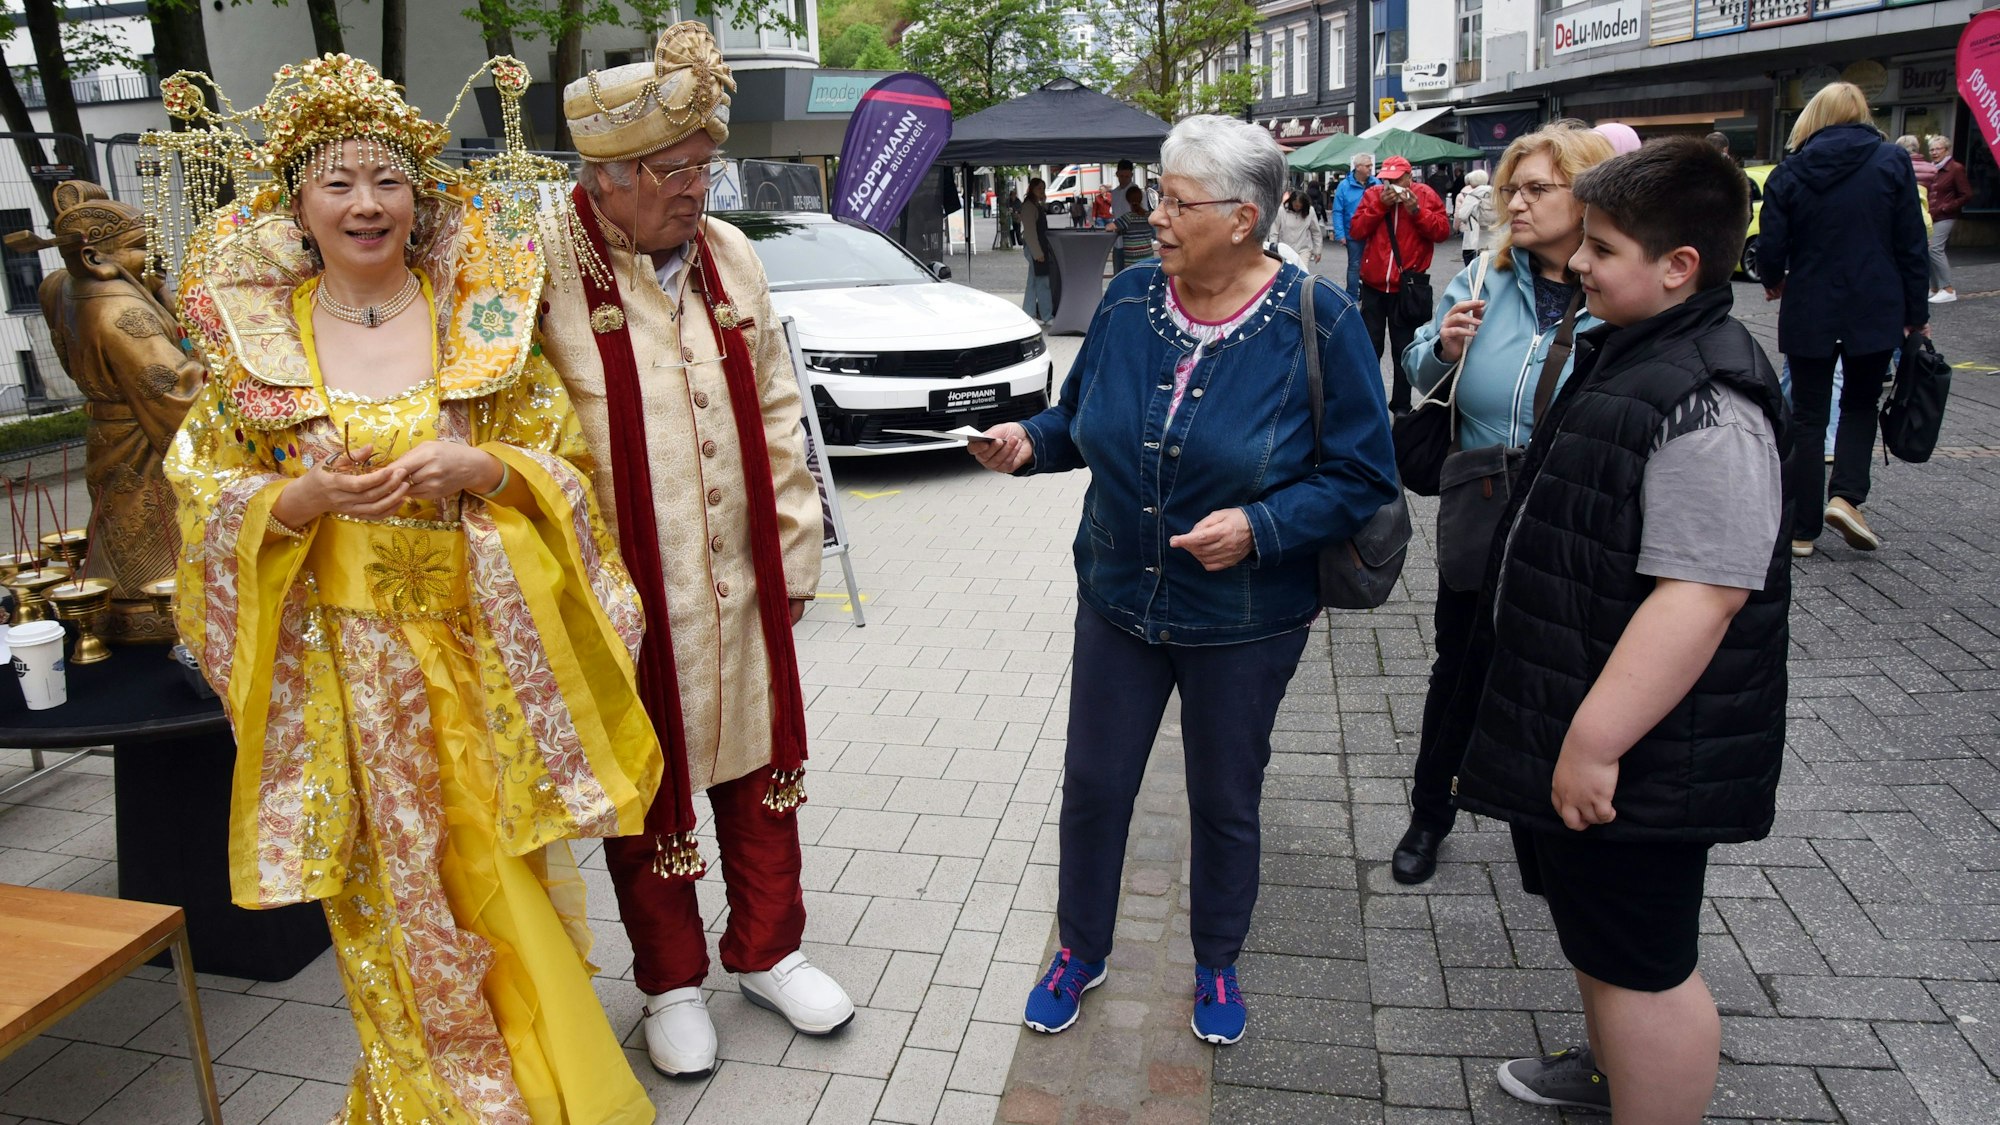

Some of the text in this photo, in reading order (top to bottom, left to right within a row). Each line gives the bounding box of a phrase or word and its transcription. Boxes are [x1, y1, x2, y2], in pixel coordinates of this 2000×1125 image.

[1555, 8, 1637, 50] DeLu-Moden
[1410, 63, 1437, 71] abak
[1418, 79, 1446, 87] more
[889, 119, 927, 172] autowelt
[847, 110, 918, 212] HOPPMANN
[948, 389, 996, 400] HOPPMANN
[972, 396, 996, 404] autowelt
